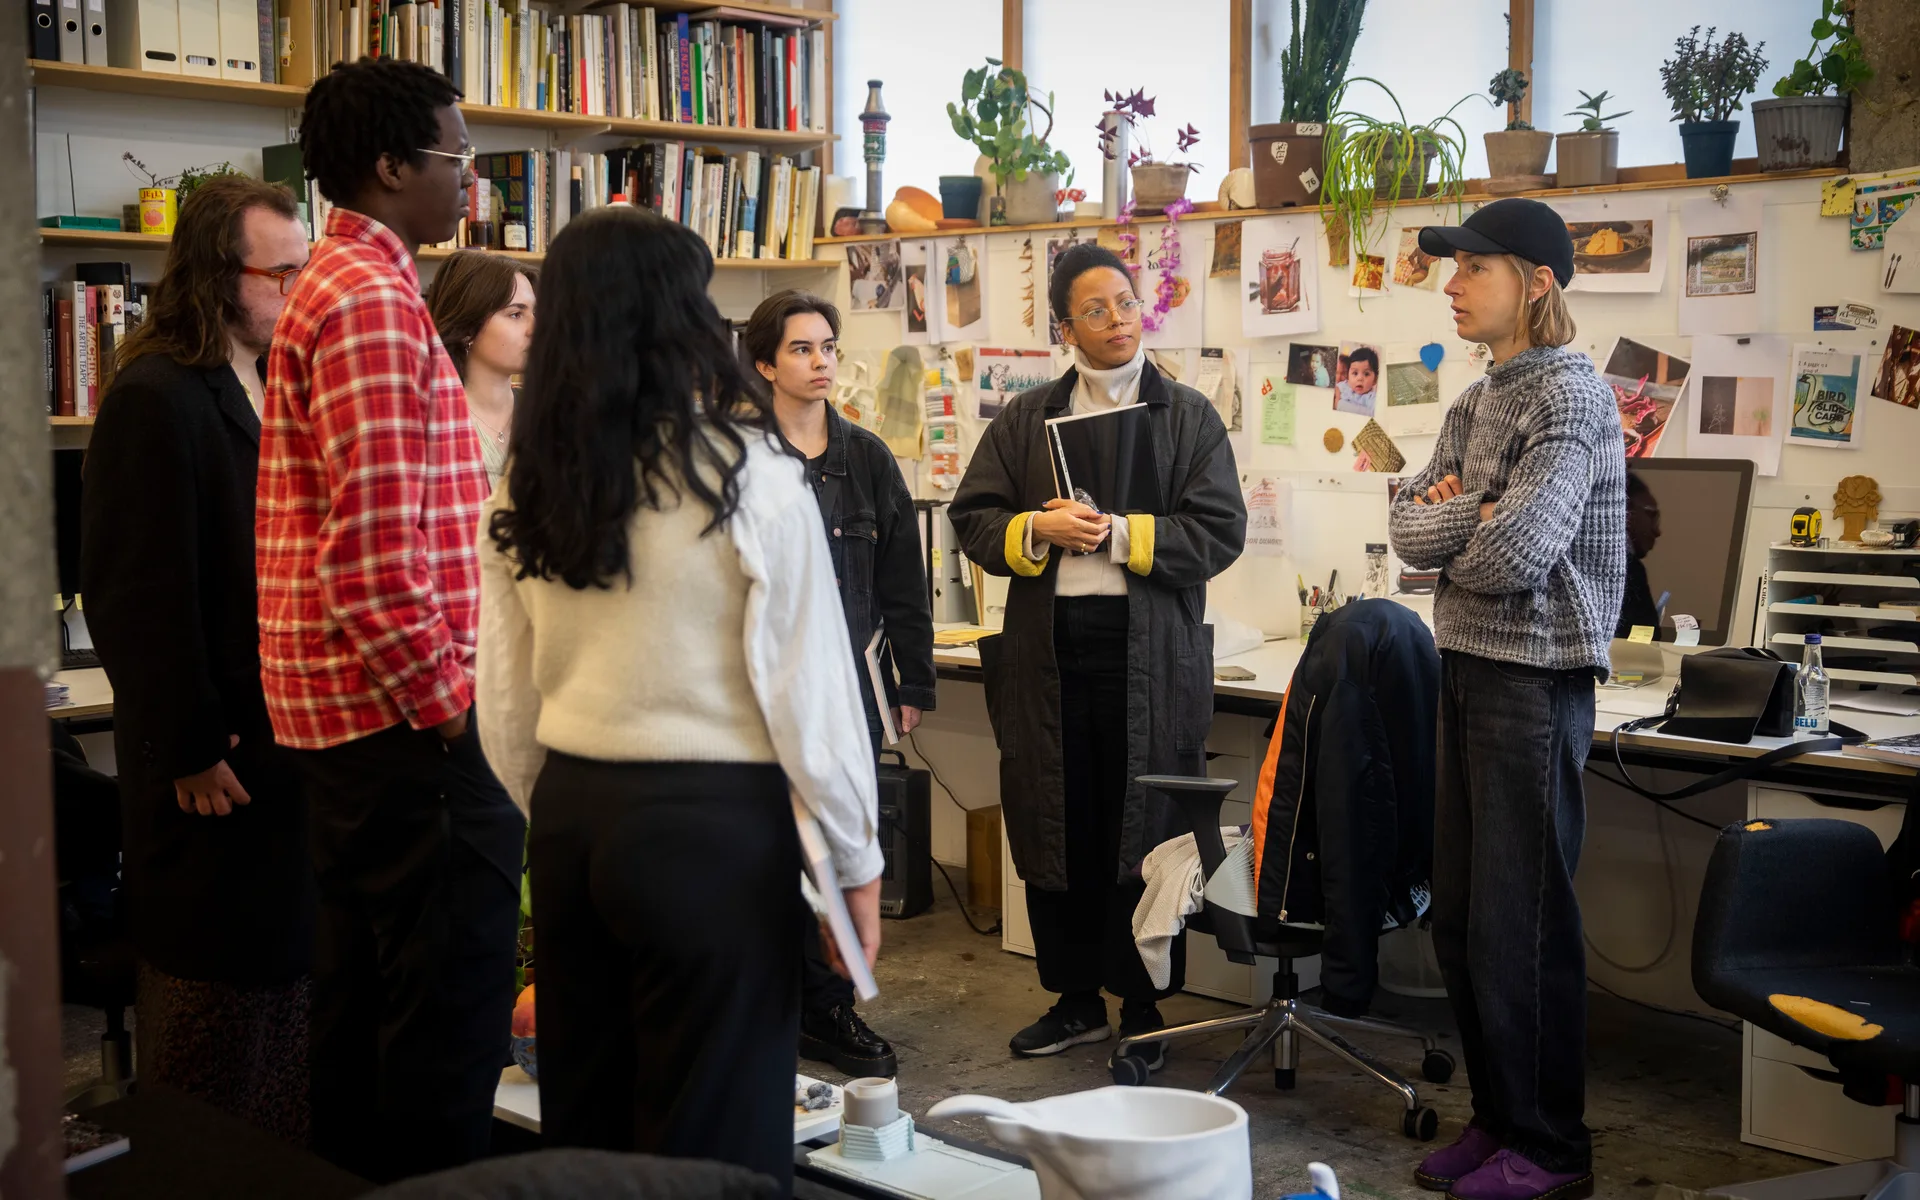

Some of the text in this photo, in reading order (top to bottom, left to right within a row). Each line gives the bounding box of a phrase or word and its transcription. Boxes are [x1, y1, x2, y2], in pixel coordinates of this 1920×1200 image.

[679, 38, 690, 91] GENZKEN
[1305, 177, 1316, 188] 76
[141, 190, 164, 199] JELLY
[78, 315, 86, 329] THE
[79, 331, 87, 357] ARTFUL
[86, 322, 97, 386] MACHINE
[1817, 390, 1847, 403] BIRD
[1795, 717, 1818, 728] BELU
